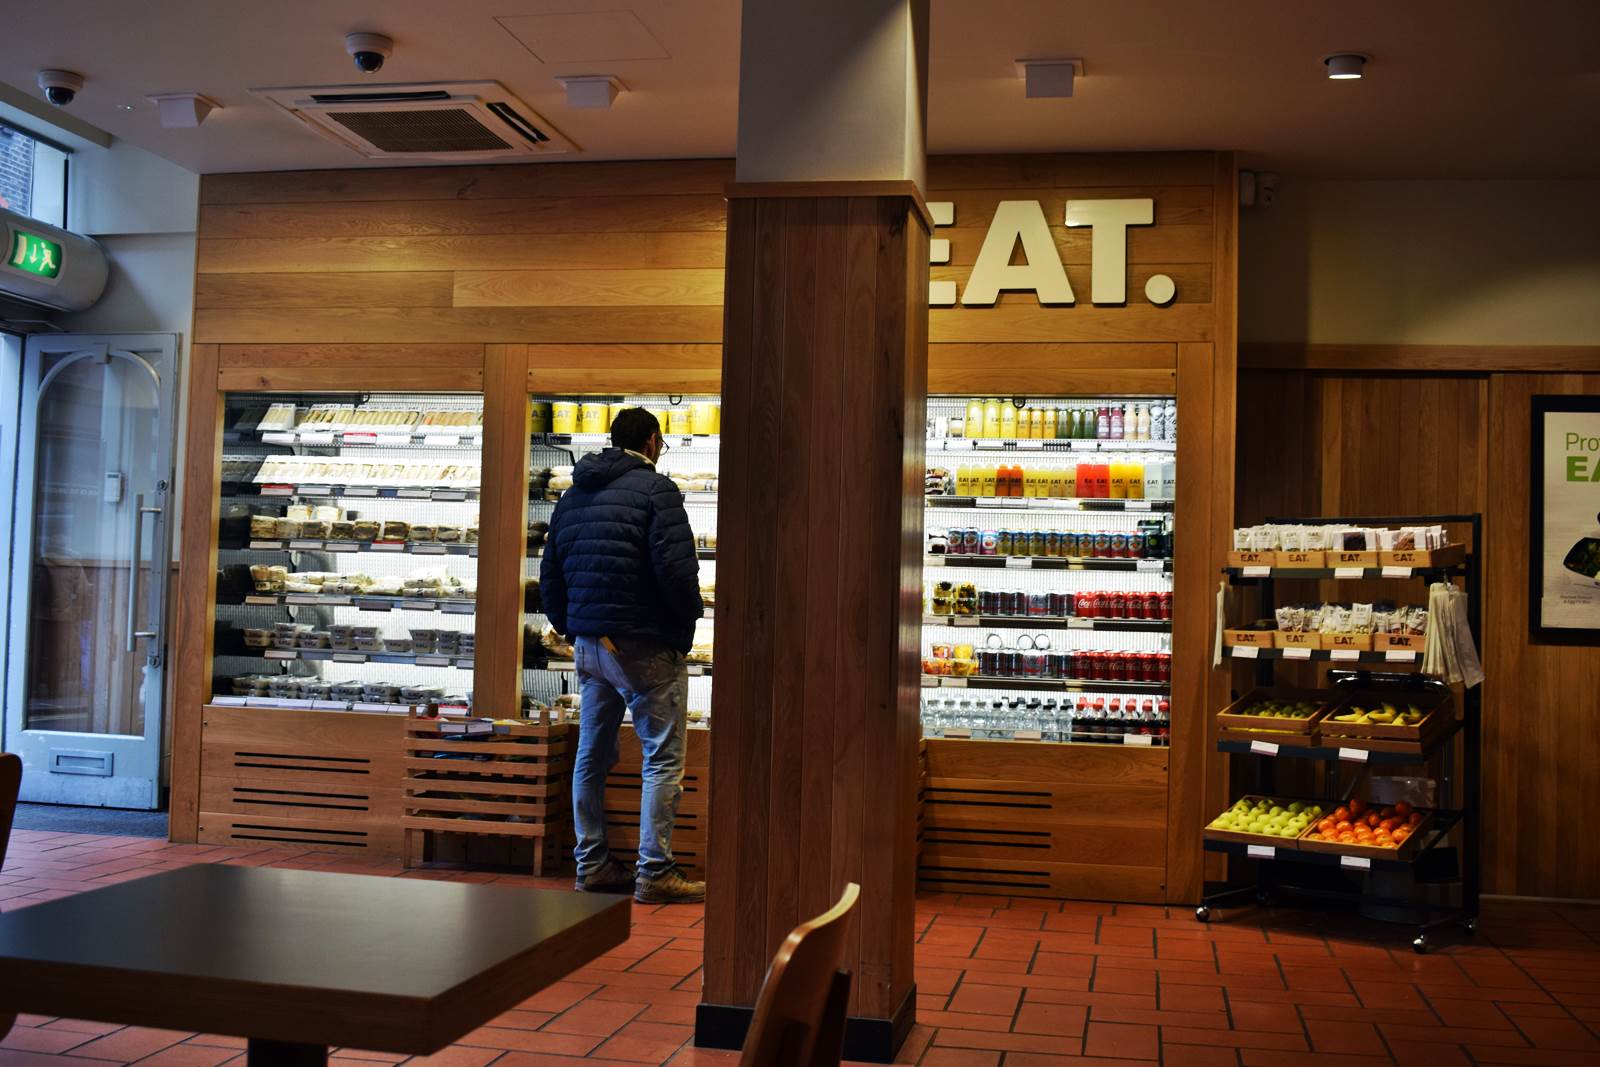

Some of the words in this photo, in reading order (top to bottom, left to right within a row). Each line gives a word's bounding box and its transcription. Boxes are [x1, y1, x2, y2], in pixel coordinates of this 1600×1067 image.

[1566, 432, 1600, 451] Pro
[1340, 554, 1361, 562] EAT.
[1333, 636, 1355, 645] EAT.
[1389, 637, 1412, 646] EAT.
